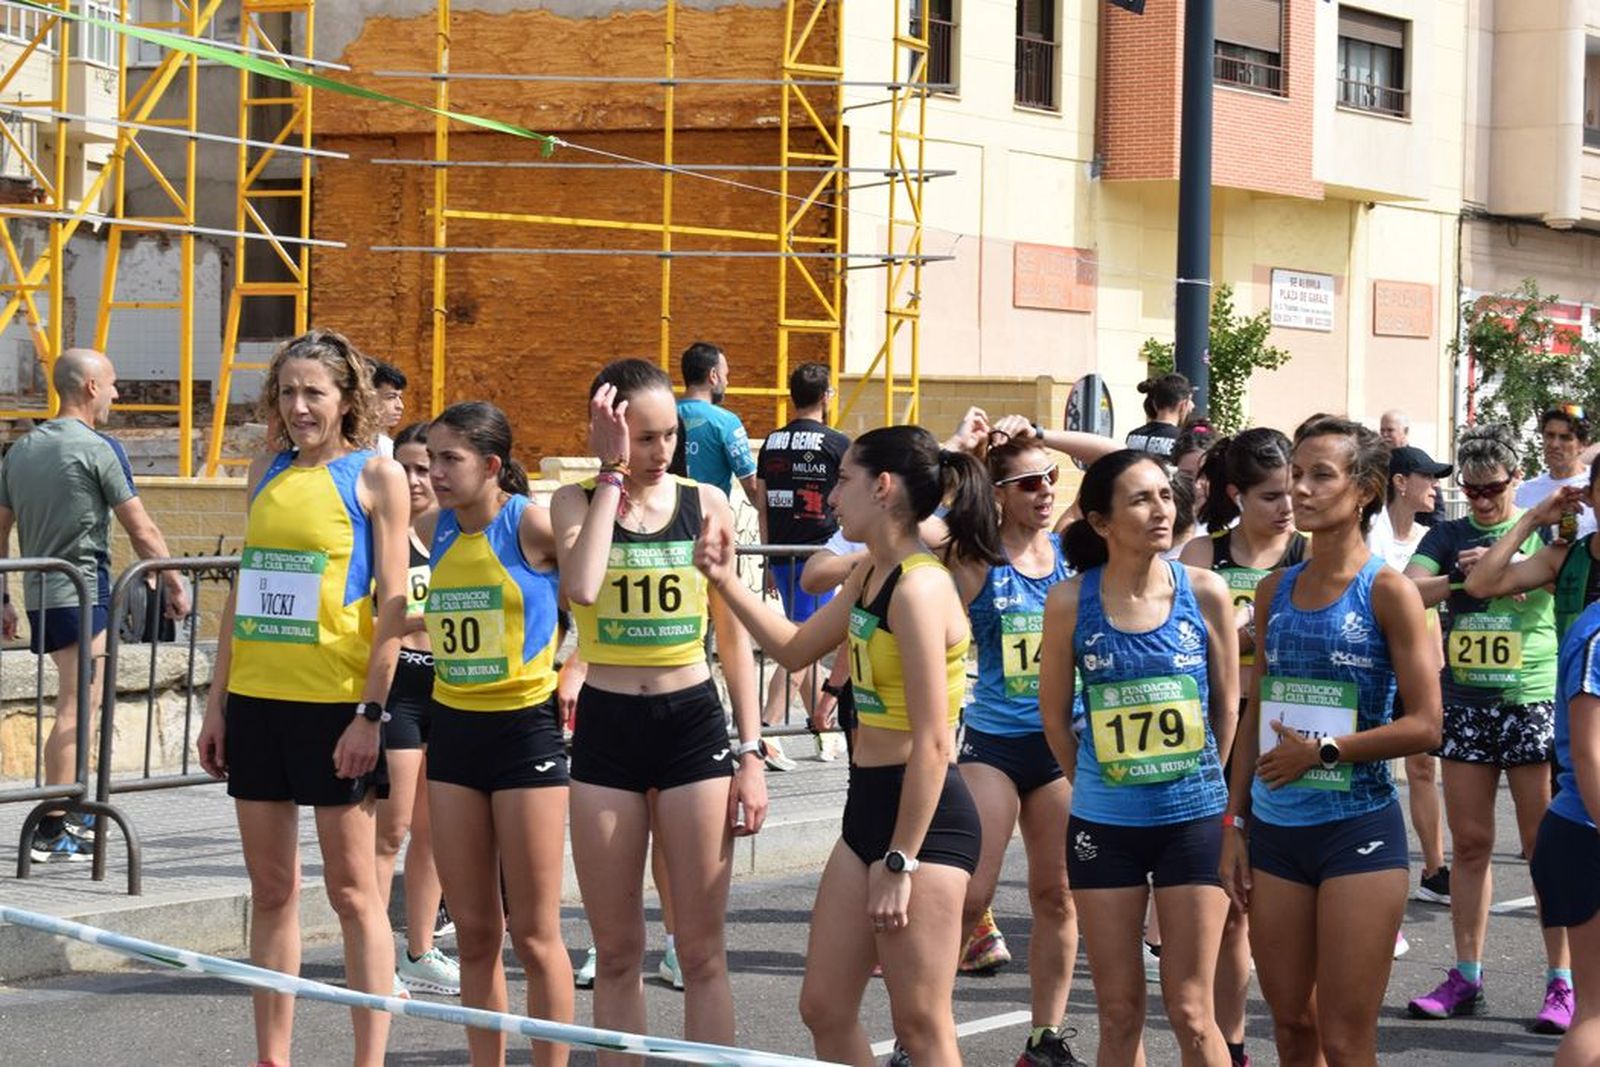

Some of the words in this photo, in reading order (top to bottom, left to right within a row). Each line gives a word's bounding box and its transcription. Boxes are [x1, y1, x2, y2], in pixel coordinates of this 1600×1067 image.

[611, 573, 682, 614] 116
[260, 592, 296, 616] VICKI
[441, 616, 481, 654] 30
[626, 626, 657, 638] CAJA
[658, 623, 696, 637] RURAL
[1458, 635, 1510, 664] 216
[1120, 680, 1183, 697] FUNDACION
[1285, 682, 1344, 698] FUNDACION
[1285, 693, 1306, 705] CAJA
[1307, 695, 1343, 707] RURAL
[1106, 708, 1185, 754] 179
[1129, 764, 1159, 777] CAJA
